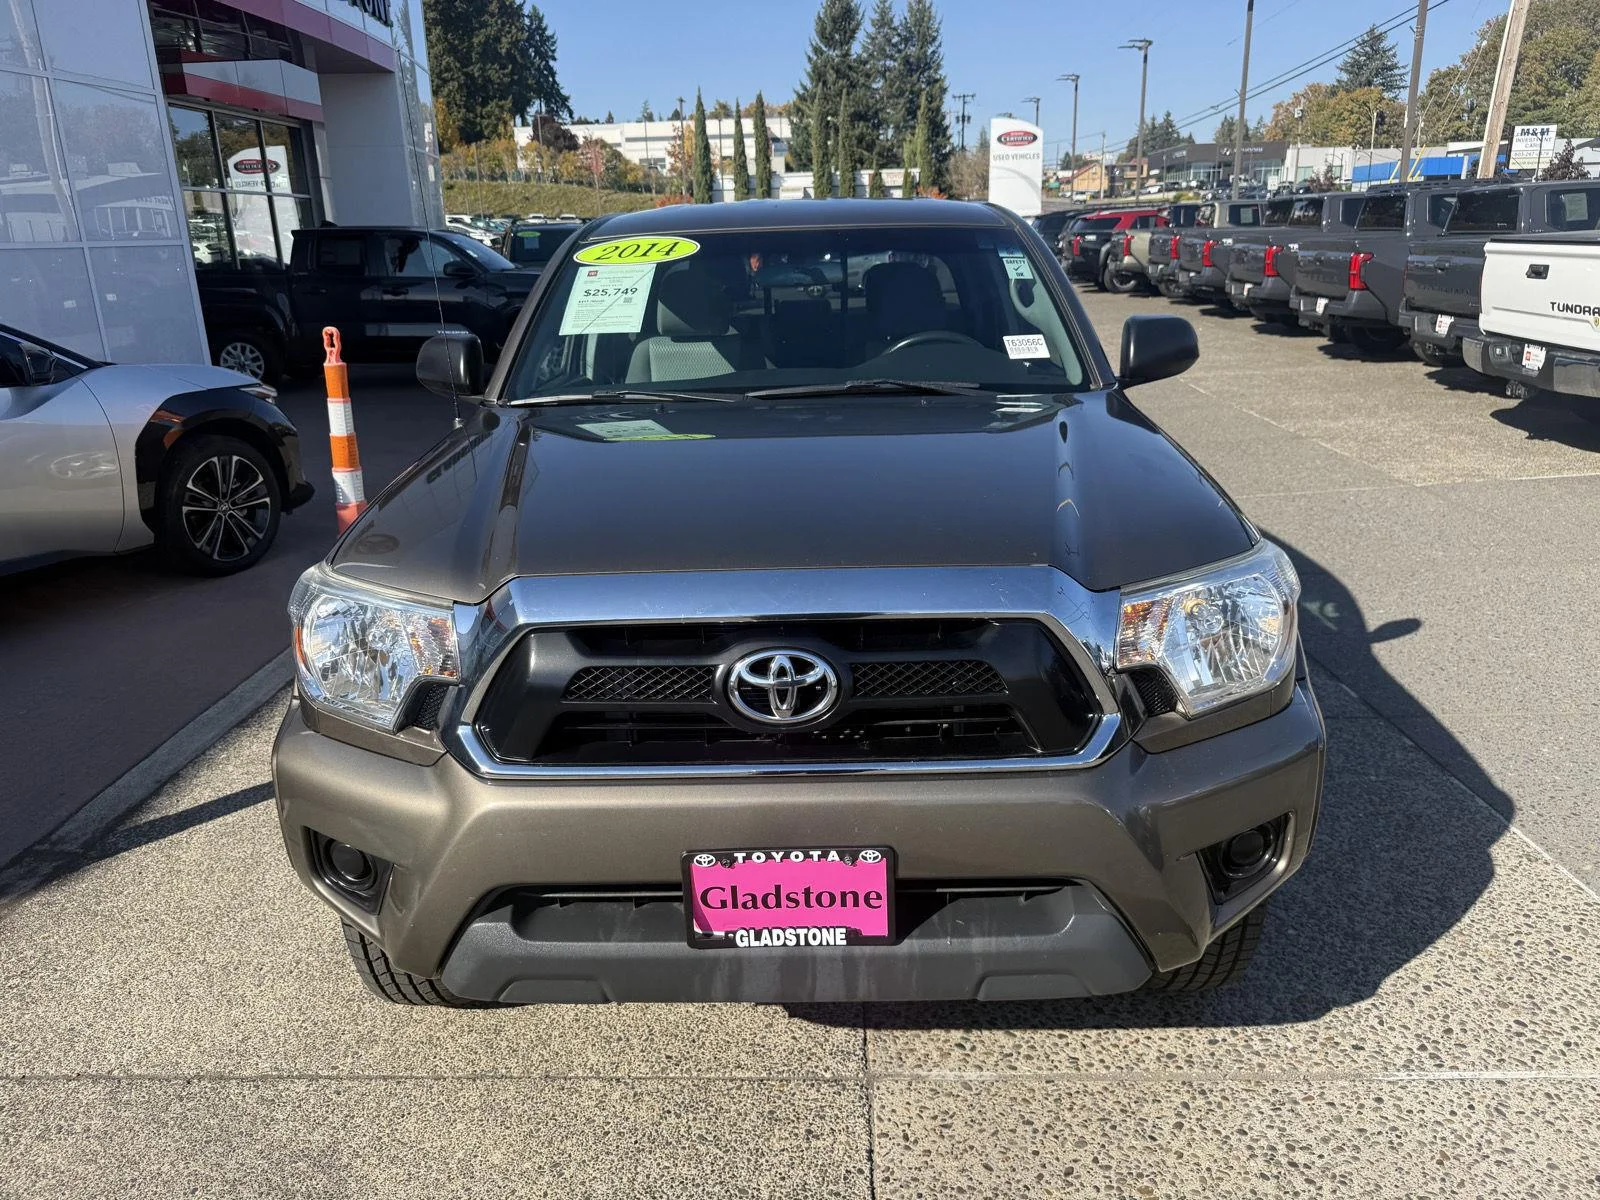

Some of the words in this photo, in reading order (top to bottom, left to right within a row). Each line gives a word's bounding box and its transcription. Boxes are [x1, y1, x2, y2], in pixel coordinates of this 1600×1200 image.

[1520, 127, 1550, 136] M&M
[993, 152, 1009, 160] USED
[1011, 152, 1040, 160] VEHICLES
[594, 241, 680, 261] 2014
[583, 287, 638, 297] $25,749
[1550, 301, 1600, 317] TUNDRA
[1006, 338, 1044, 347] T63056C
[734, 850, 840, 863] TOYOTA
[700, 884, 883, 910] Gladstone
[735, 928, 847, 947] GLADSTONE
